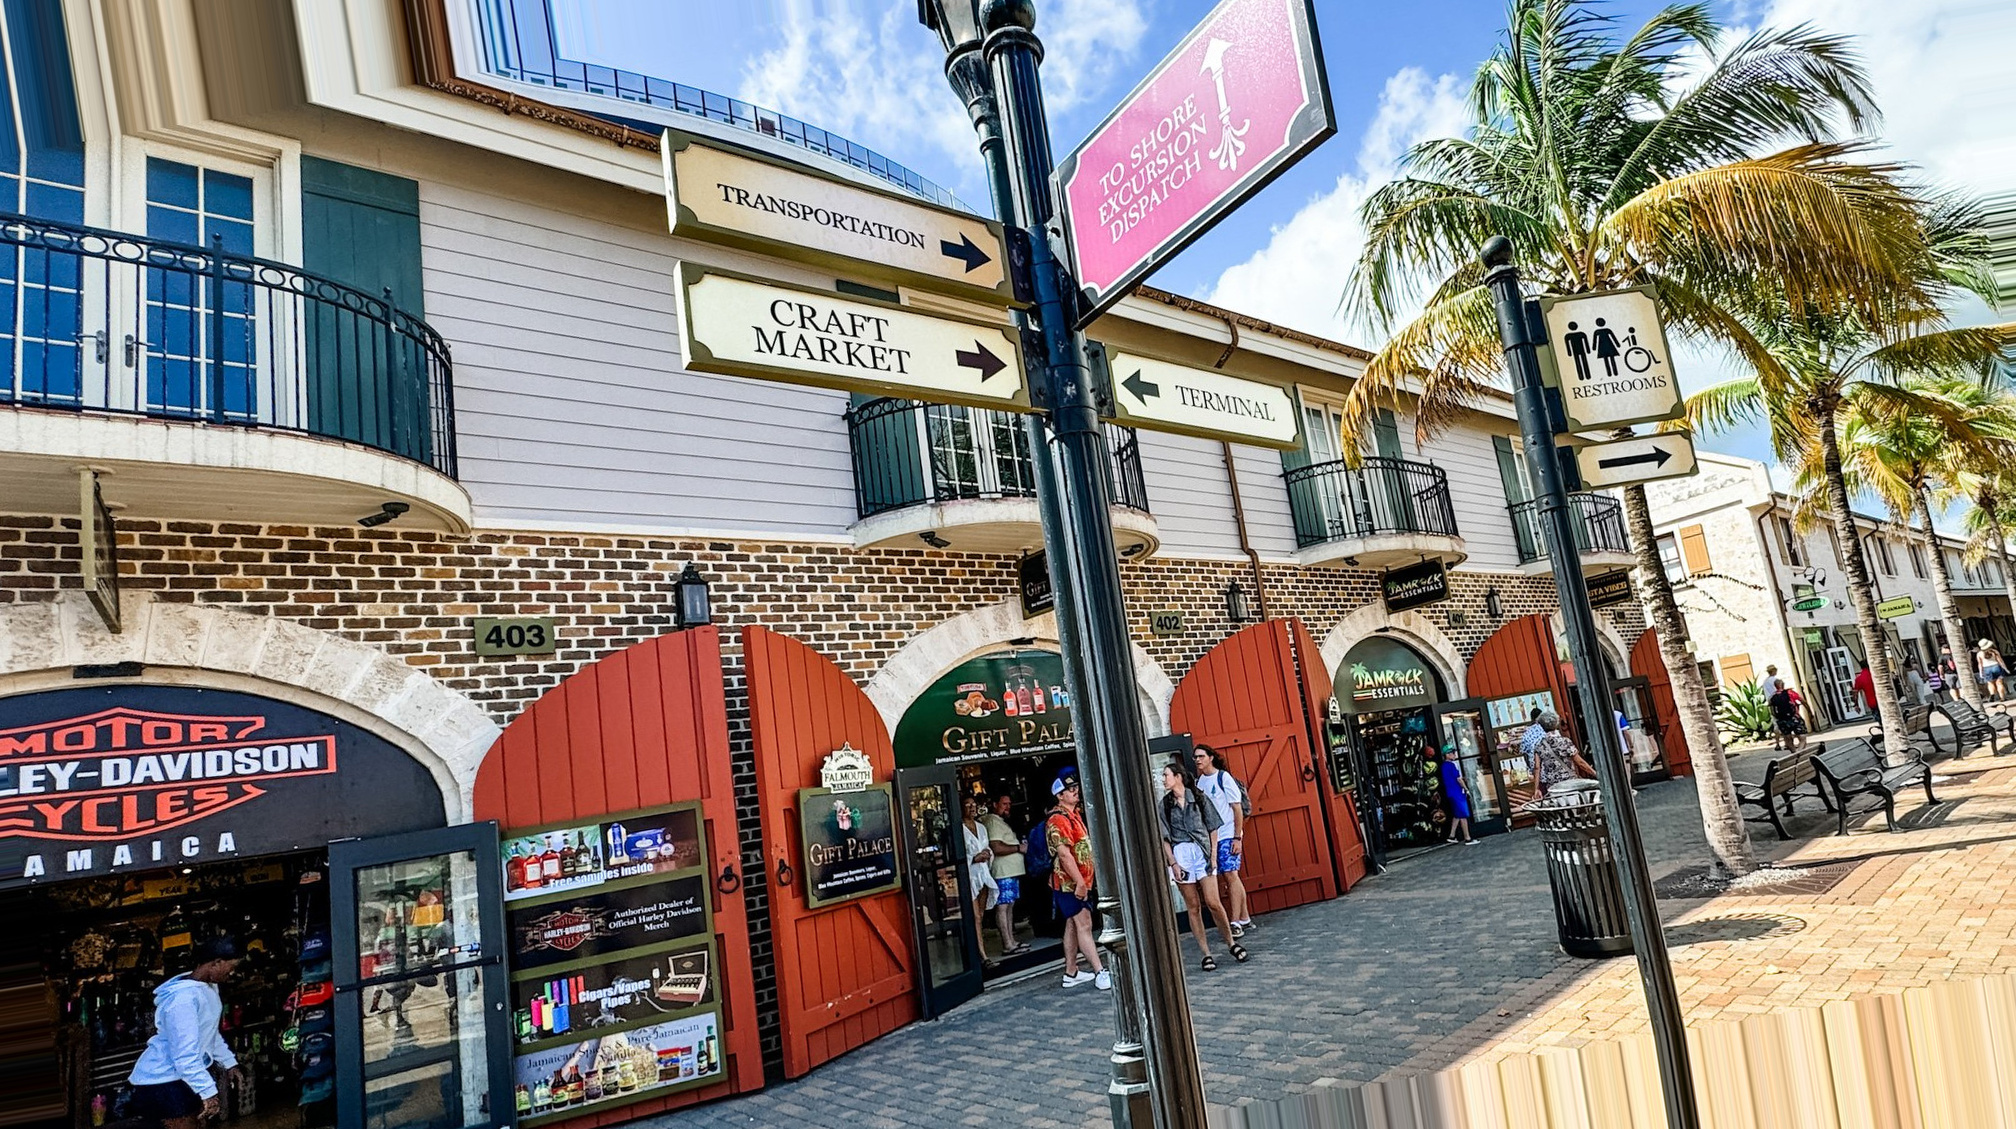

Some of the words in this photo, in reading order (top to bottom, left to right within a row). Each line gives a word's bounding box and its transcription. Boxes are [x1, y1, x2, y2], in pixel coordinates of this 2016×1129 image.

[1099, 162, 1125, 197] TO
[1130, 93, 1197, 169] SHORE
[1098, 113, 1207, 227] EXCURSION
[1110, 150, 1202, 245] DISPATCH
[717, 183, 926, 250] TRANSPORTATION
[770, 299, 889, 342] CRAFT
[751, 325, 911, 374] MARKET
[1572, 375, 1667, 400] RESTROOMS
[1175, 385, 1276, 421] TERMINAL
[1156, 616, 1180, 630] 402
[485, 624, 546, 648] 403
[1372, 684, 1425, 699] ESSENTIALS
[0, 716, 229, 755] MOTOR
[942, 726, 1010, 753] GIFT
[936, 755, 960, 764] Jamaican
[824, 771, 871, 782] FALMOUTH
[809, 843, 843, 867] GIFT
[846, 837, 893, 860] PALACE
[549, 877, 573, 888] Free
[575, 869, 619, 882] samples
[608, 917, 637, 929] Official
[638, 913, 665, 924] Harley
[666, 906, 702, 918] Davidson
[614, 903, 657, 919] Authorized
[659, 900, 684, 910] Dealer
[685, 897, 694, 905] of
[644, 920, 670, 932] Merch
[601, 994, 631, 1009] Pipes
[628, 1036, 652, 1045] Pure
[654, 1024, 700, 1040] Jamaican
[527, 1051, 575, 1069] Jamaican
